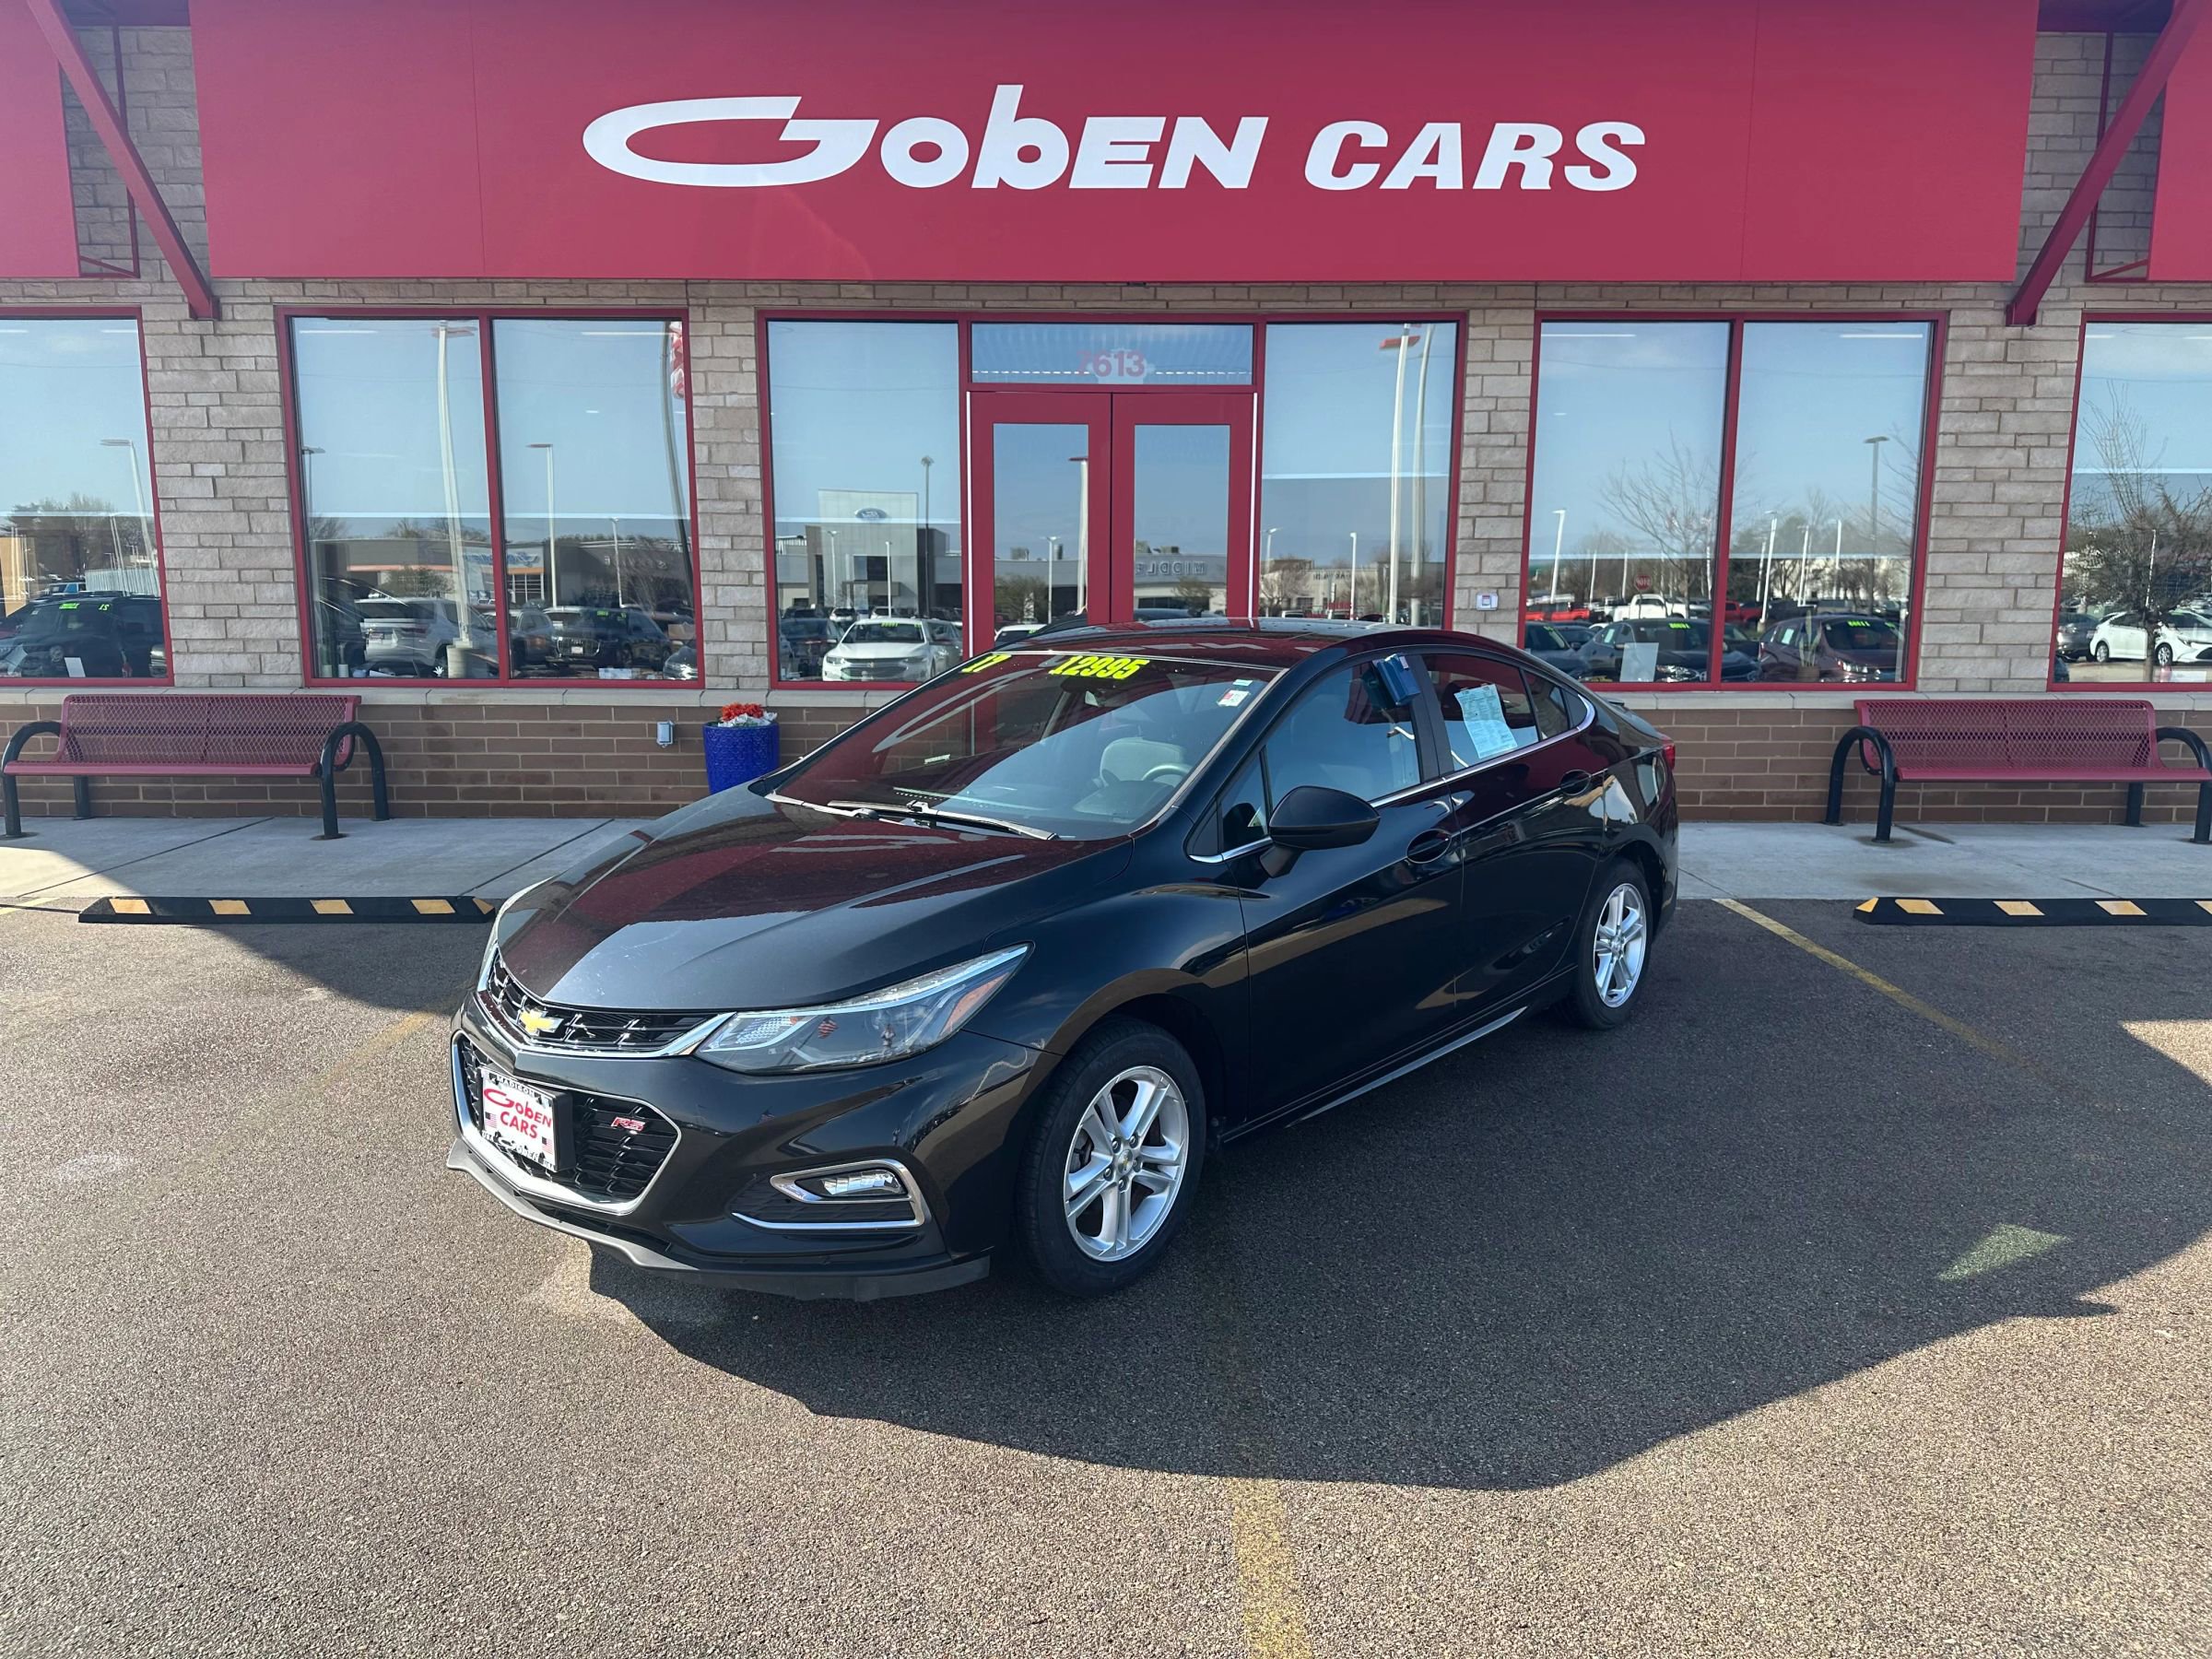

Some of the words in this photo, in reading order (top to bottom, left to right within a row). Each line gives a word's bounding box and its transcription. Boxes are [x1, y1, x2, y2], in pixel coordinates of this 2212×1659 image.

[1304, 121, 1646, 192] CARS
[1076, 349, 1145, 378] 7613
[1048, 654, 1151, 680] 12995
[500, 1111, 539, 1139] CARS
[610, 1116, 646, 1132] RS
